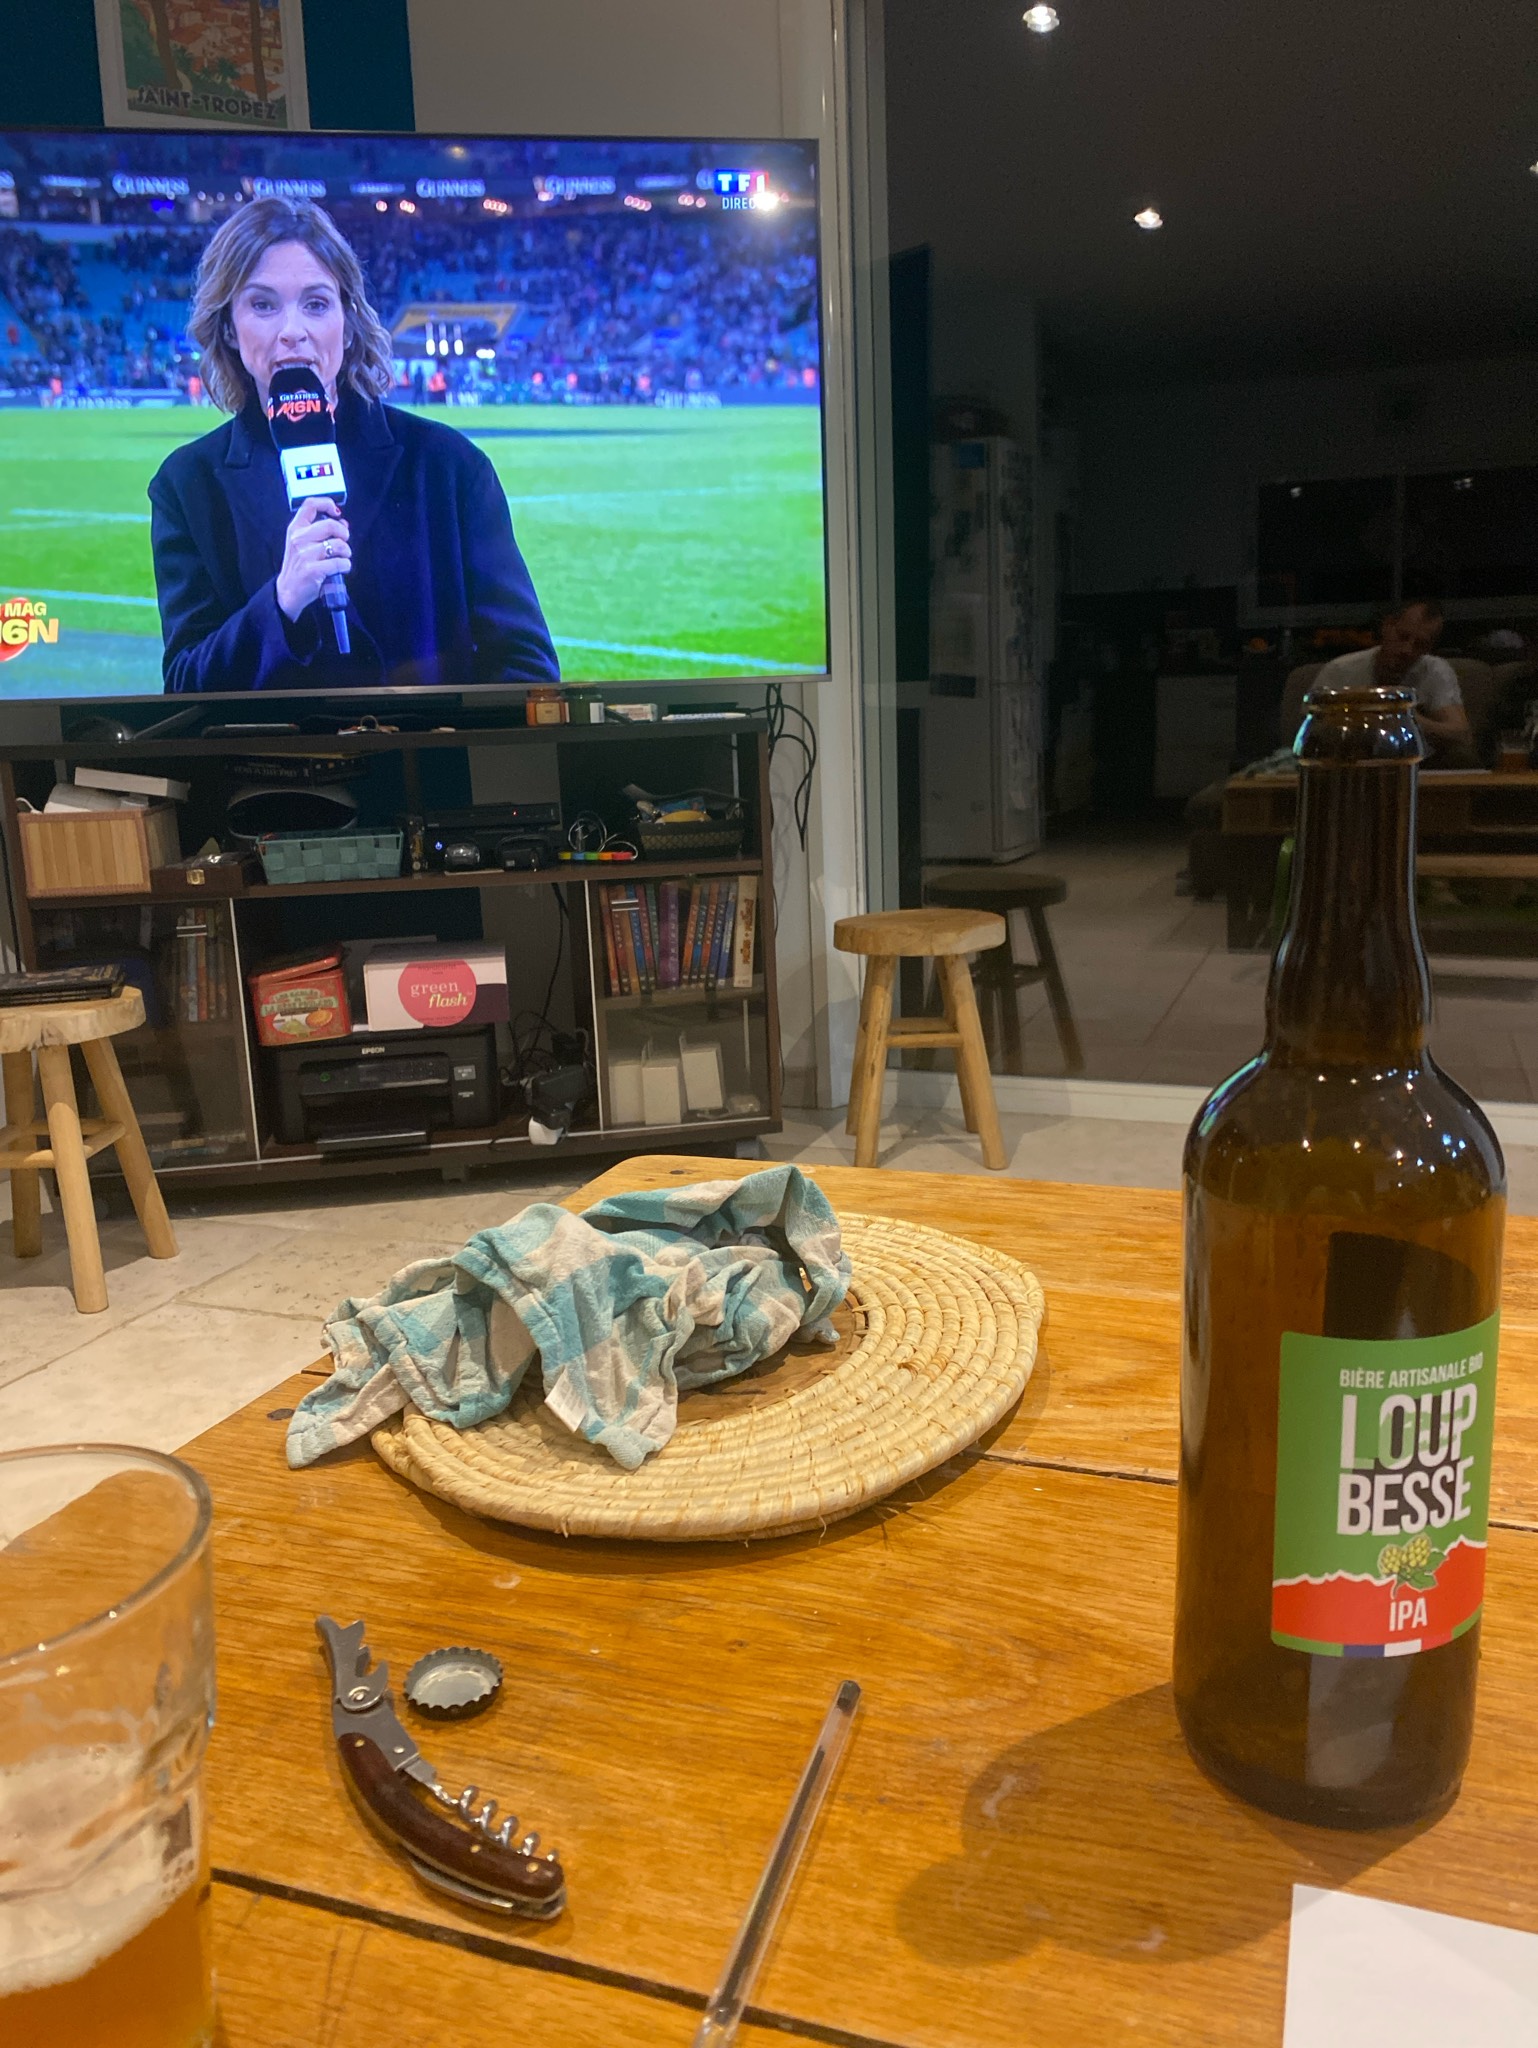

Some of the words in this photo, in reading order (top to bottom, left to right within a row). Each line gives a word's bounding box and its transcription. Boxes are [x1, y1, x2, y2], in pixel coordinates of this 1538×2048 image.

[137, 86, 276, 120] SAINT-TROPEZ
[717, 173, 765, 192] TF1
[722, 197, 758, 210] DIREC
[4, 602, 47, 617] MAG
[0, 618, 59, 645] 6N
[410, 981, 459, 998] green
[429, 992, 467, 1009] flash
[361, 1046, 385, 1055] EPSON
[1340, 1367, 1385, 1389] BIÈRE
[1388, 1359, 1467, 1388] ARTISANALE
[1340, 1383, 1478, 1470] LOUP
[1337, 1455, 1474, 1536] BESSE
[1389, 1597, 1428, 1632] IPA
